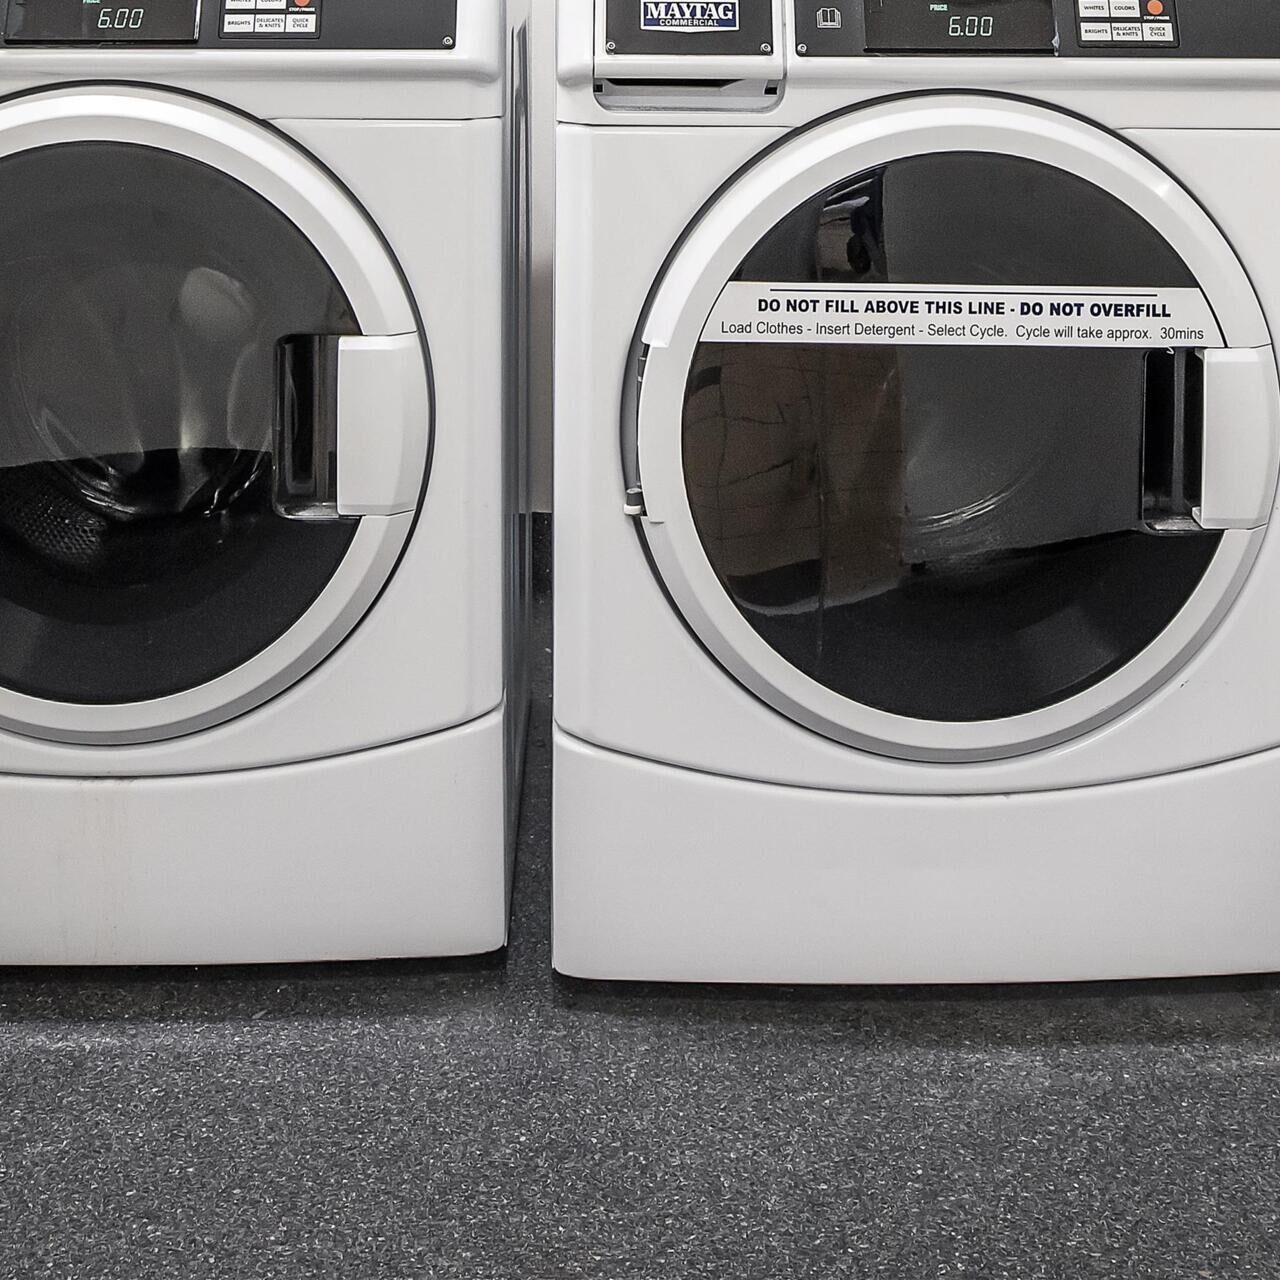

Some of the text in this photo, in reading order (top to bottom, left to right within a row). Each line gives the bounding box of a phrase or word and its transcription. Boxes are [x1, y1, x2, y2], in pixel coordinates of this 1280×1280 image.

[98, 8, 144, 28] 6.00
[645, 3, 733, 19] MAYTAG
[949, 16, 993, 36] 6.00
[758, 299, 781, 312] DO
[786, 299, 820, 313] NOT
[825, 300, 859, 313] FILL
[864, 300, 920, 314] ABOVE
[925, 301, 963, 314] THIS
[968, 302, 1005, 315] LINE
[1020, 302, 1044, 316] DO
[1049, 302, 1084, 317] NOT
[1090, 303, 1171, 318] OVERFILL
[721, 321, 752, 334] Load
[756, 321, 803, 335] Clothes
[816, 322, 851, 335] Insert
[854, 322, 915, 339] Detergent
[927, 323, 966, 337] Select
[970, 324, 1008, 340] Cycle.
[1016, 325, 1050, 341] Cycle
[1054, 325, 1073, 339] will
[1077, 326, 1103, 339] take
[1107, 329, 1152, 342] approx.
[1160, 327, 1204, 340] 30mins
